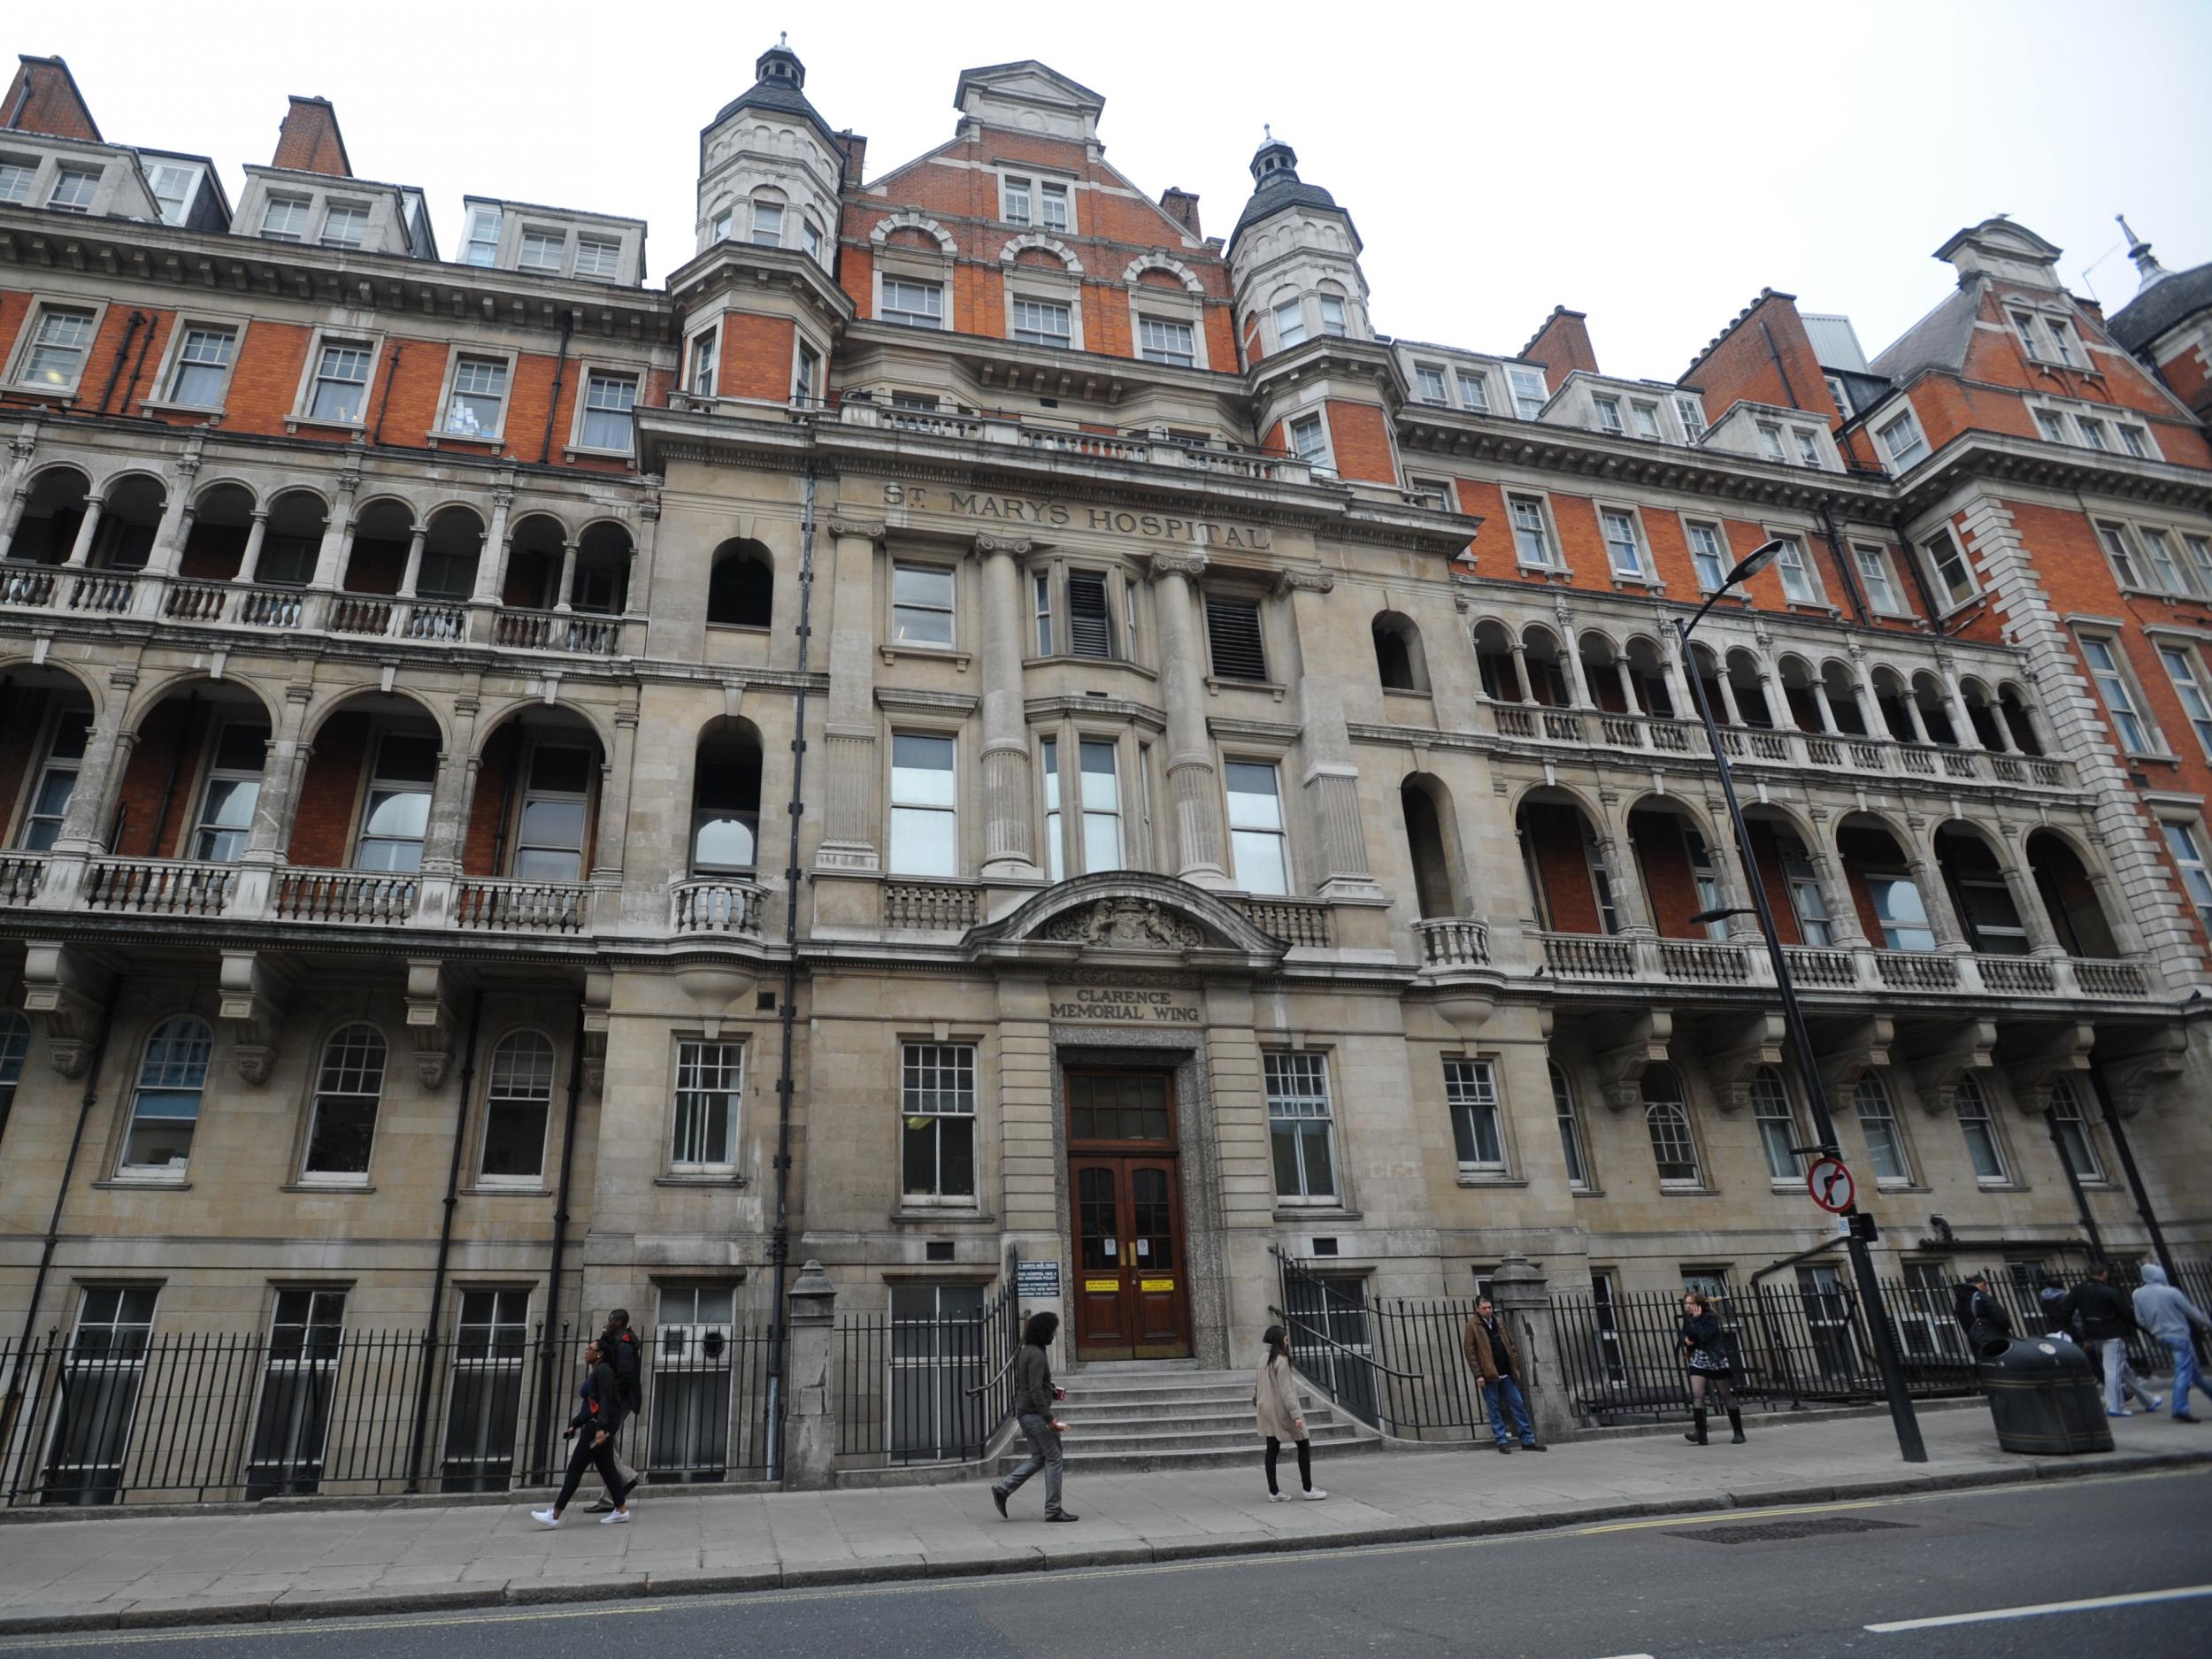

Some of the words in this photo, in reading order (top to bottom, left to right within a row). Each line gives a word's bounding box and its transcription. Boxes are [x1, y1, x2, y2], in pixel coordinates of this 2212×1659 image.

[949, 491, 1070, 525] MARY'S
[1088, 509, 1271, 549] HOSPITAL
[1077, 989, 1172, 1004] CLARENCE
[1050, 1002, 1144, 1019] MEMORIAL
[1153, 1006, 1200, 1021] WING
